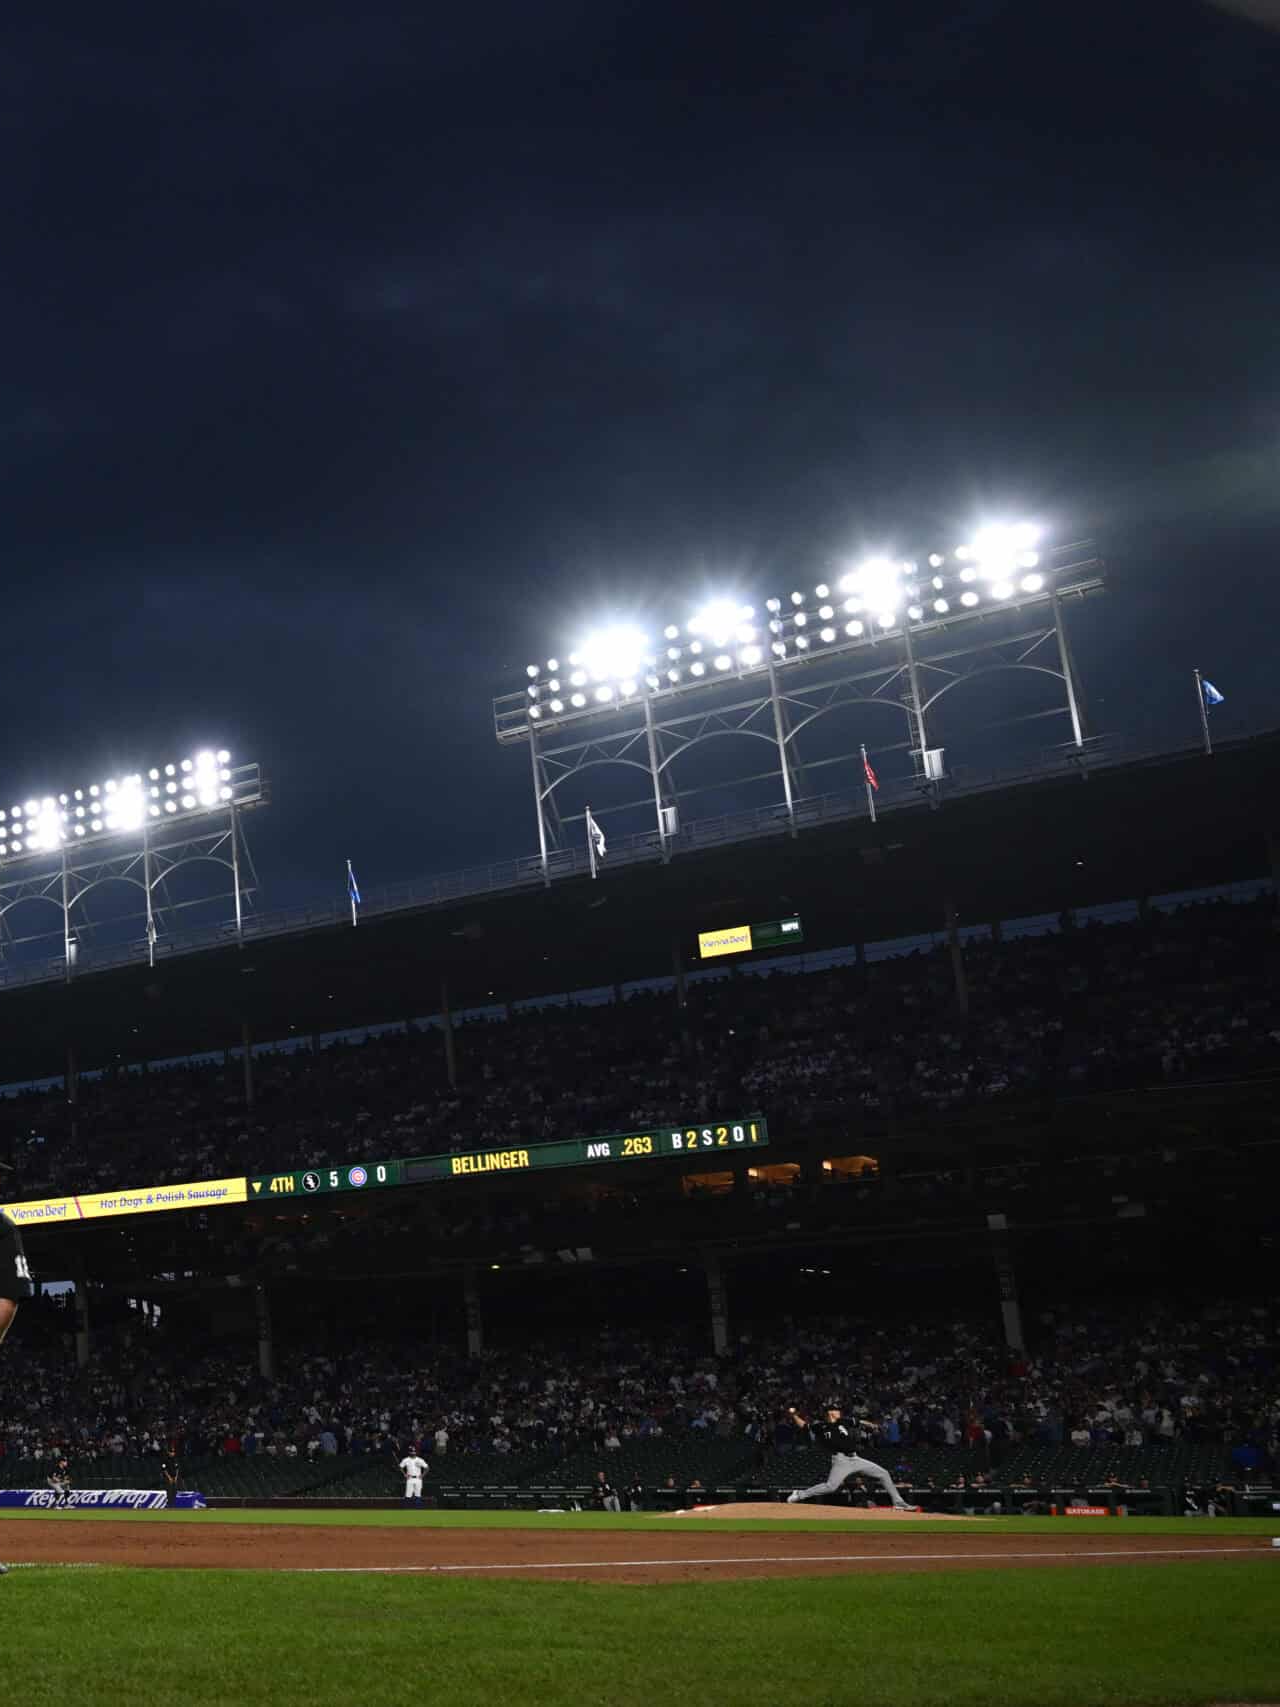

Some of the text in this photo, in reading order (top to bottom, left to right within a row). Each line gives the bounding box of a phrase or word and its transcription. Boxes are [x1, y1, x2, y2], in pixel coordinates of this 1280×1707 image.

[587, 1137, 652, 1158] AVG .263
[672, 1133, 683, 1149] B
[686, 1131, 697, 1149] 2
[702, 1129, 713, 1146] S
[716, 1127, 728, 1145] 2
[452, 1150, 529, 1175] BELLINGER
[270, 1175, 294, 1193] 4TH
[329, 1170, 339, 1187] 5
[377, 1165, 386, 1182] 0
[11, 1187, 228, 1219] Vienna Beef Hot Dogs & Polish Sausage
[102, 1489, 149, 1509] Wrap
